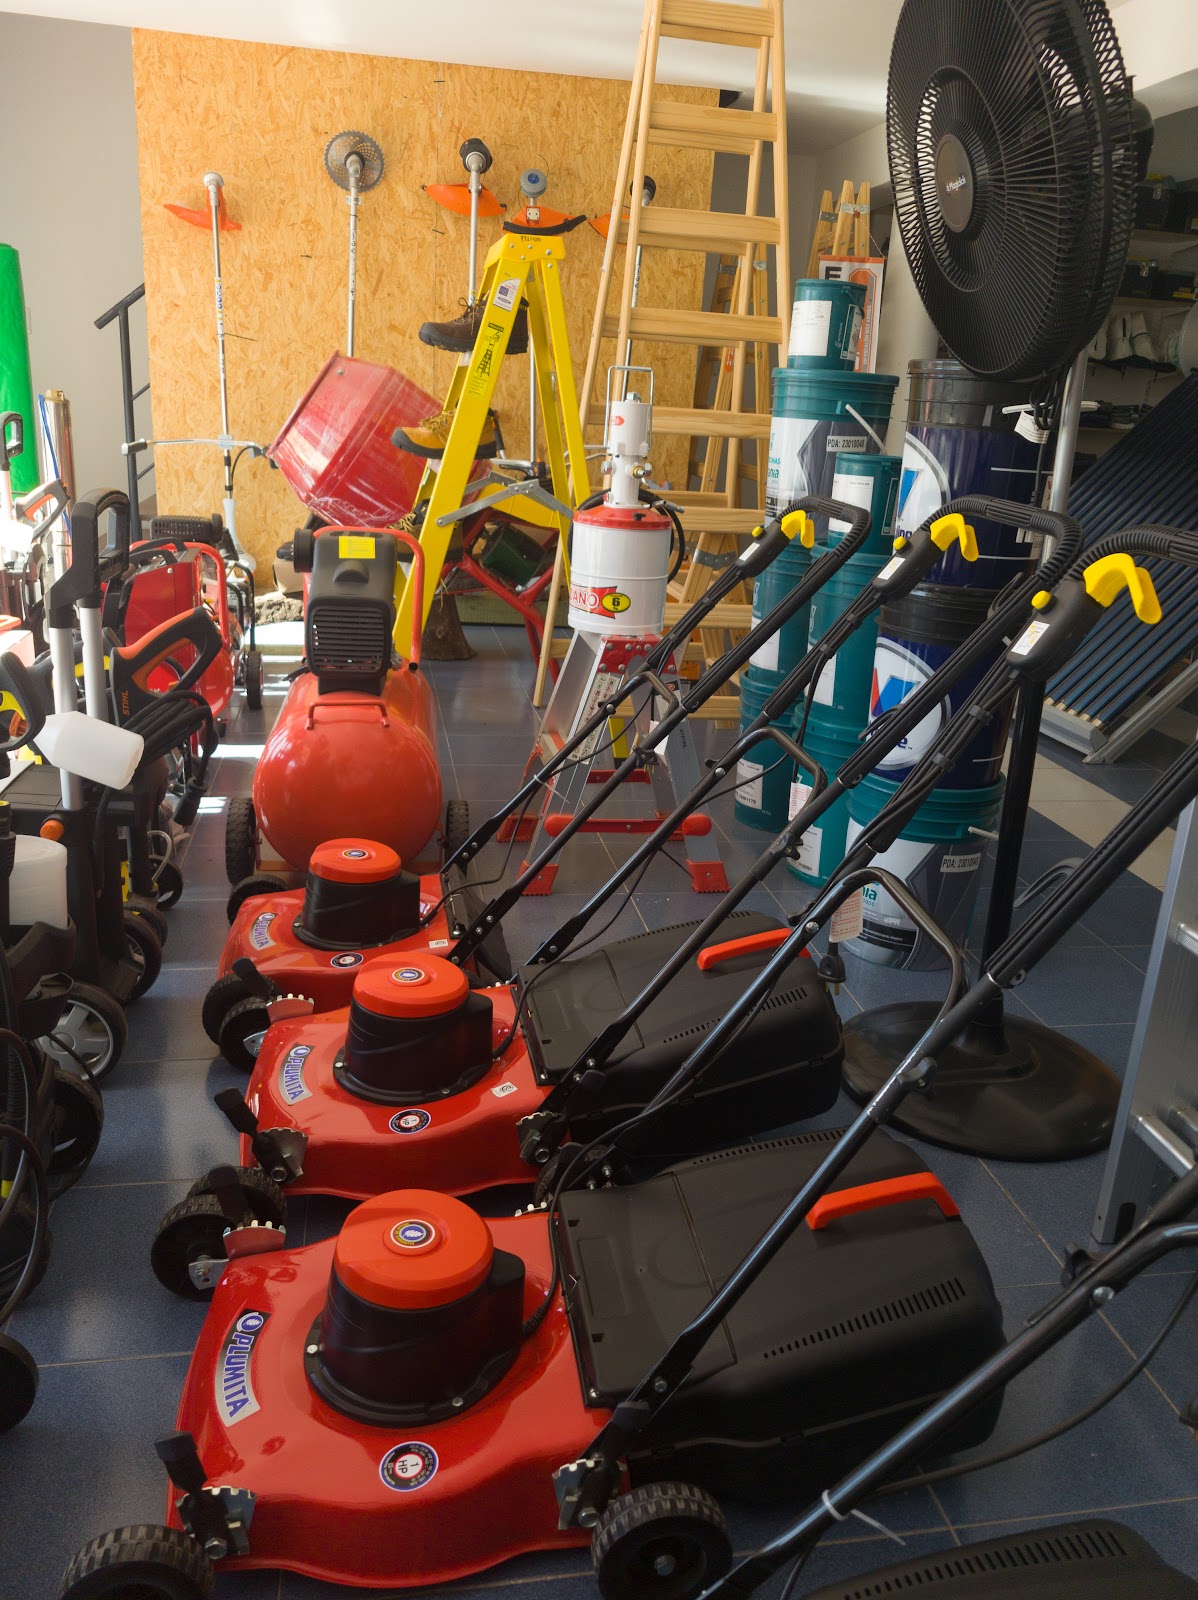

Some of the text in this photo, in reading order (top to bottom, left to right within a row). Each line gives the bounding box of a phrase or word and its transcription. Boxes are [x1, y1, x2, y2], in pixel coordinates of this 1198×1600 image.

[828, 439, 840, 448] PDA:
[612, 598, 620, 606] 6
[122, 689, 130, 716] STIHL
[284, 1056, 305, 1100] PLUMITA
[223, 1332, 254, 1418] PLUMITA
[398, 1460, 408, 1474] HP
